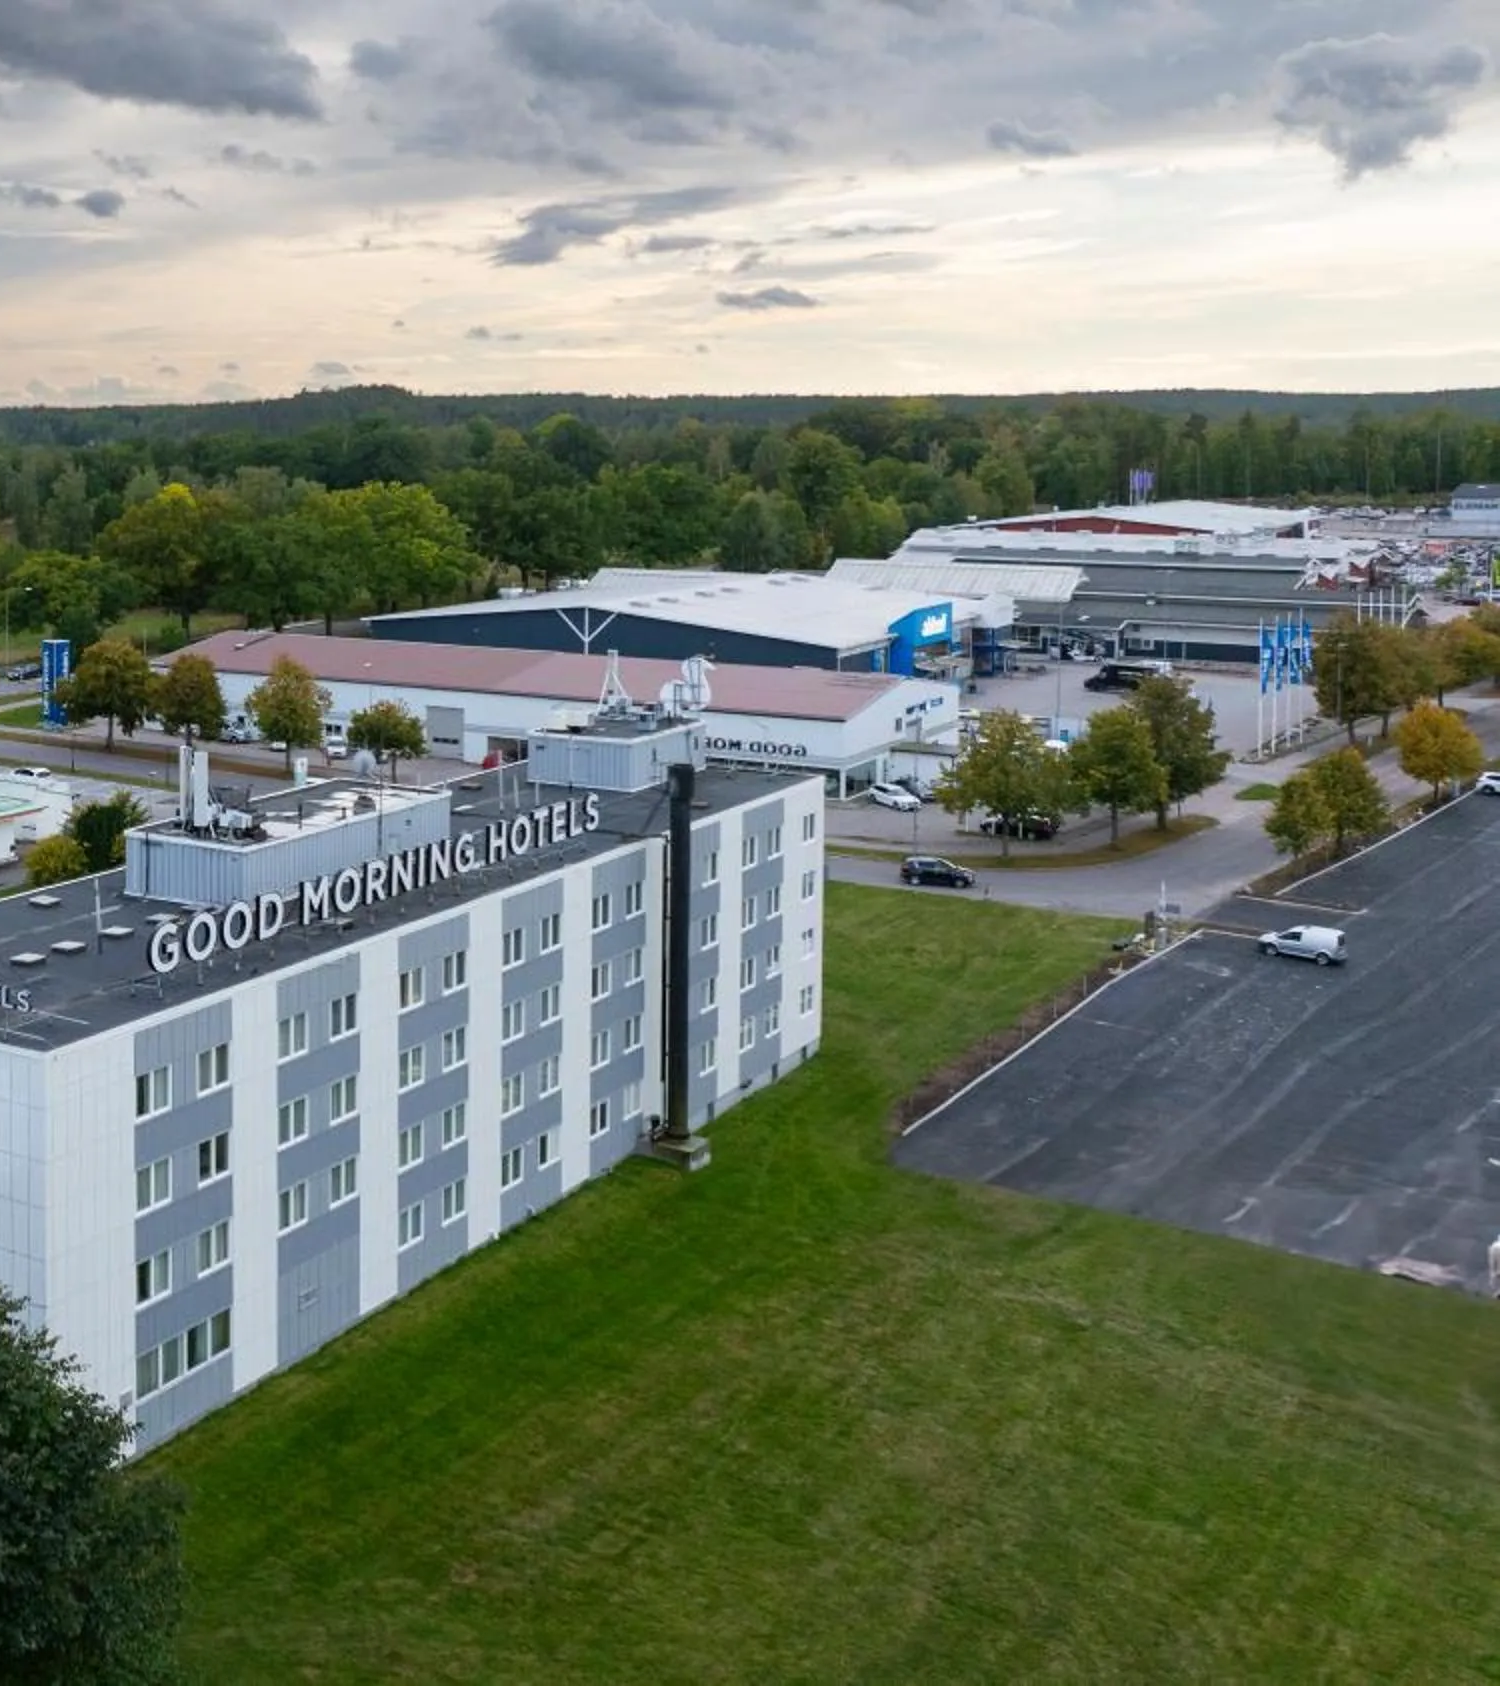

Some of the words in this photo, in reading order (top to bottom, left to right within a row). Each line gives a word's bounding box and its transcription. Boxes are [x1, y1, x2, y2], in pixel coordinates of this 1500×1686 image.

[149, 893, 285, 974] GOOD
[301, 832, 475, 925] MORNING
[486, 794, 600, 863] HOTELS
